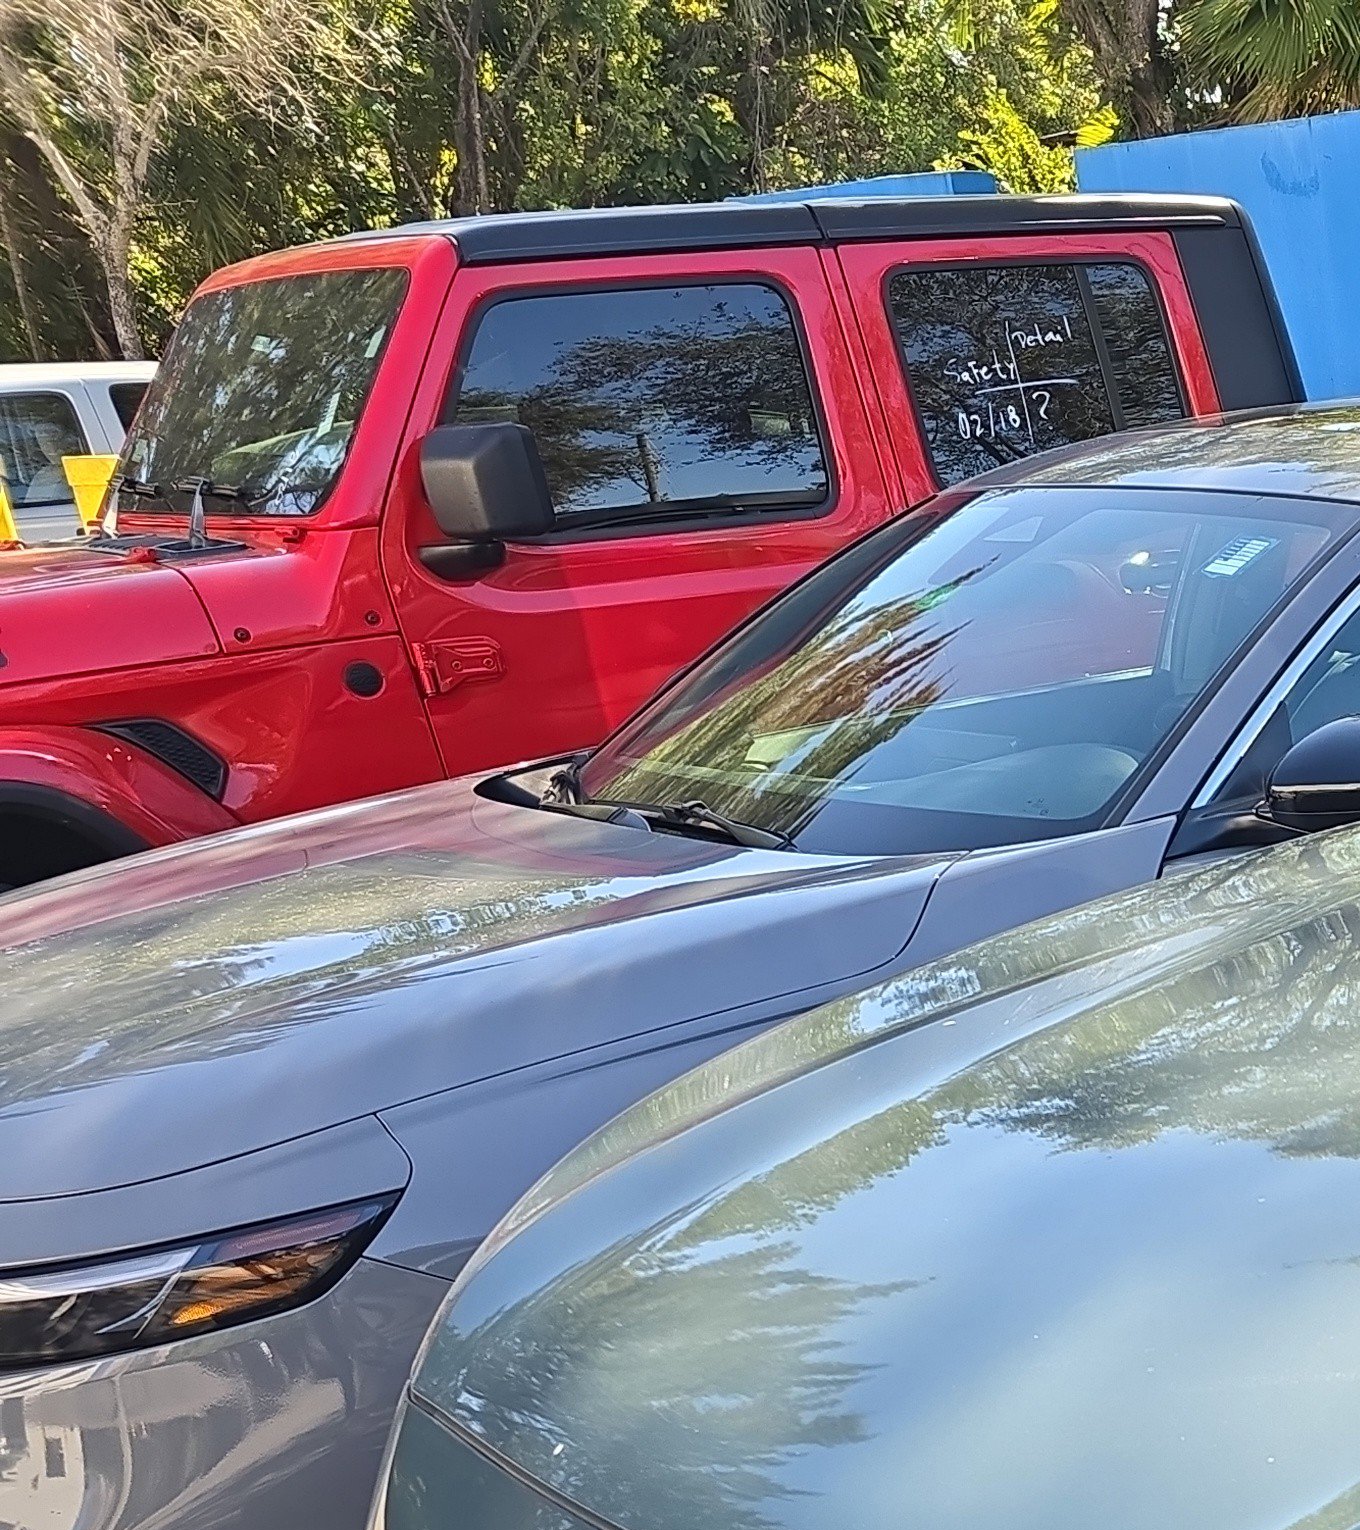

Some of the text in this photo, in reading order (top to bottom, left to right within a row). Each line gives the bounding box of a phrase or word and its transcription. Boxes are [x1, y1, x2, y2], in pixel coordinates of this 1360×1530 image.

[1011, 314, 1073, 349] Detail
[958, 401, 1021, 439] 02/18
[1032, 391, 1051, 430] ?
